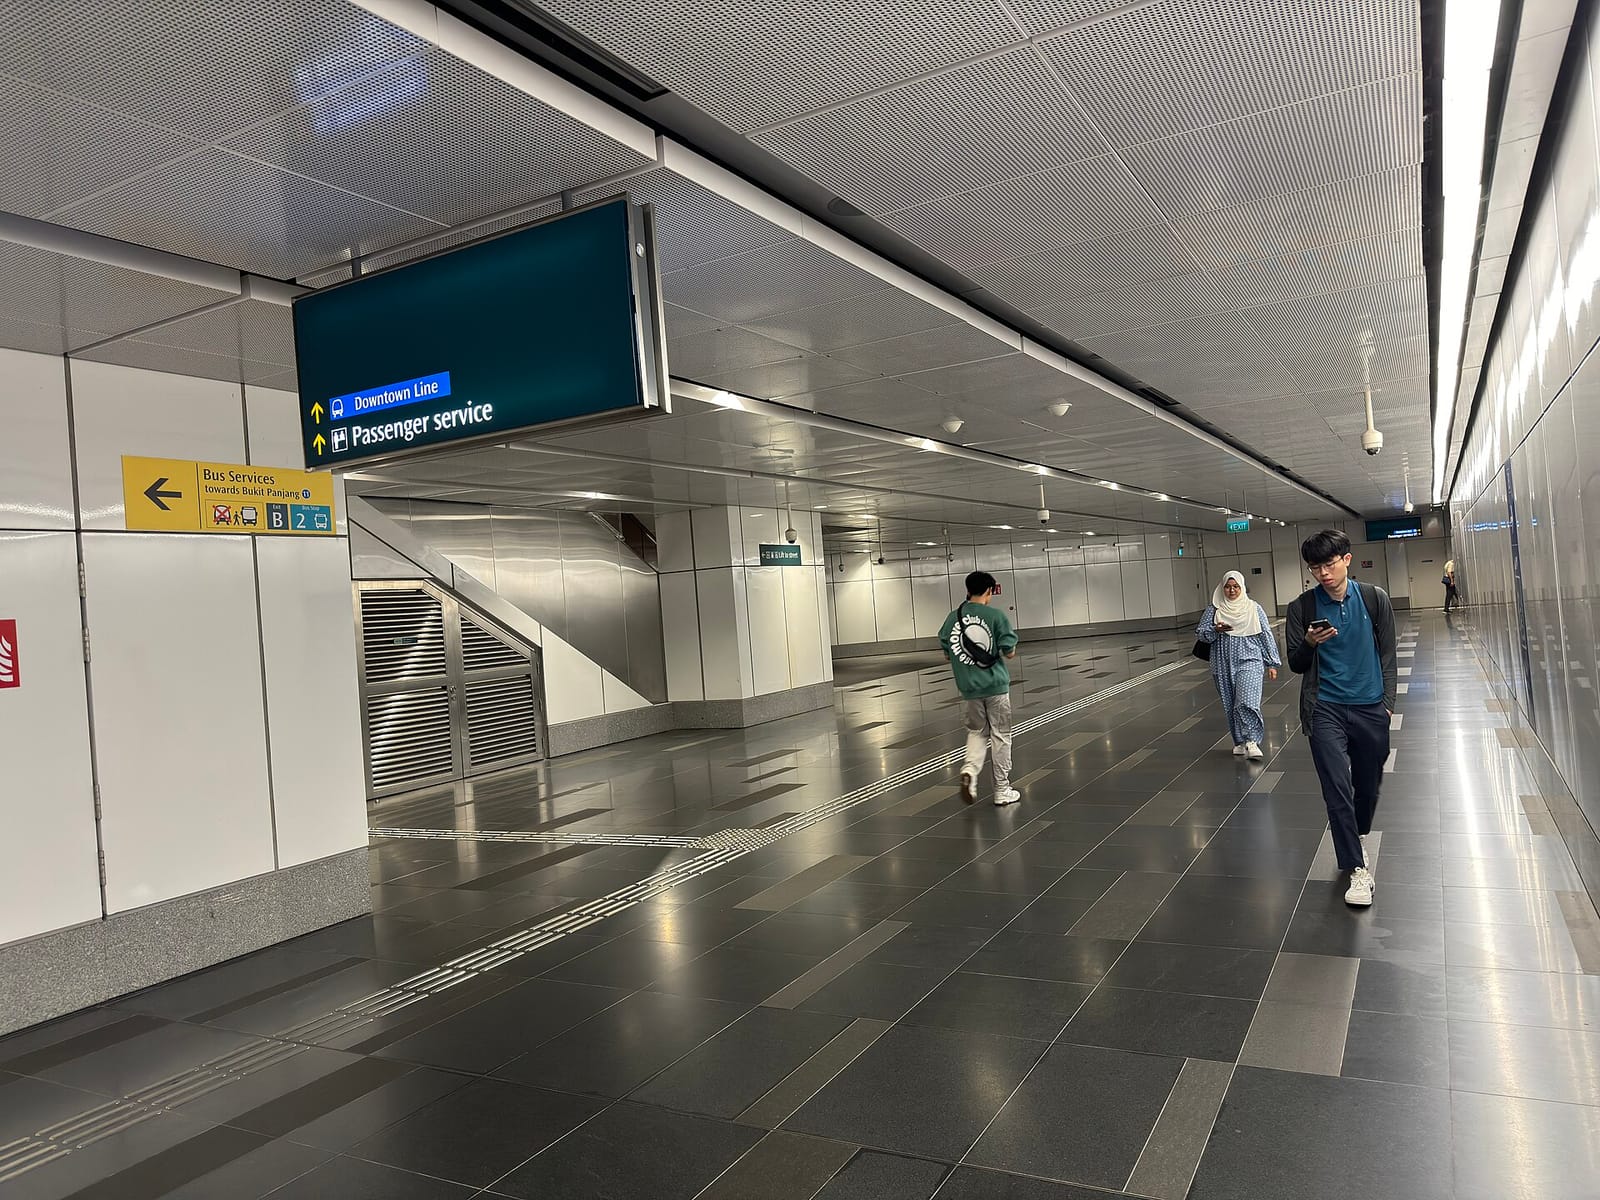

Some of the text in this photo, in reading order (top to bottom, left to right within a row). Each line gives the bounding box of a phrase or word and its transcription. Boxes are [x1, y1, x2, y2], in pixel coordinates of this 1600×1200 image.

[354, 381, 438, 411] Downtown Line
[352, 400, 493, 447] Passenger service
[203, 469, 275, 485] Bus Services
[204, 485, 300, 500] towards Bukit Panjang
[272, 511, 283, 528] B
[296, 513, 306, 529] 2
[1233, 522, 1246, 531] EXIT
[962, 614, 981, 625] club
